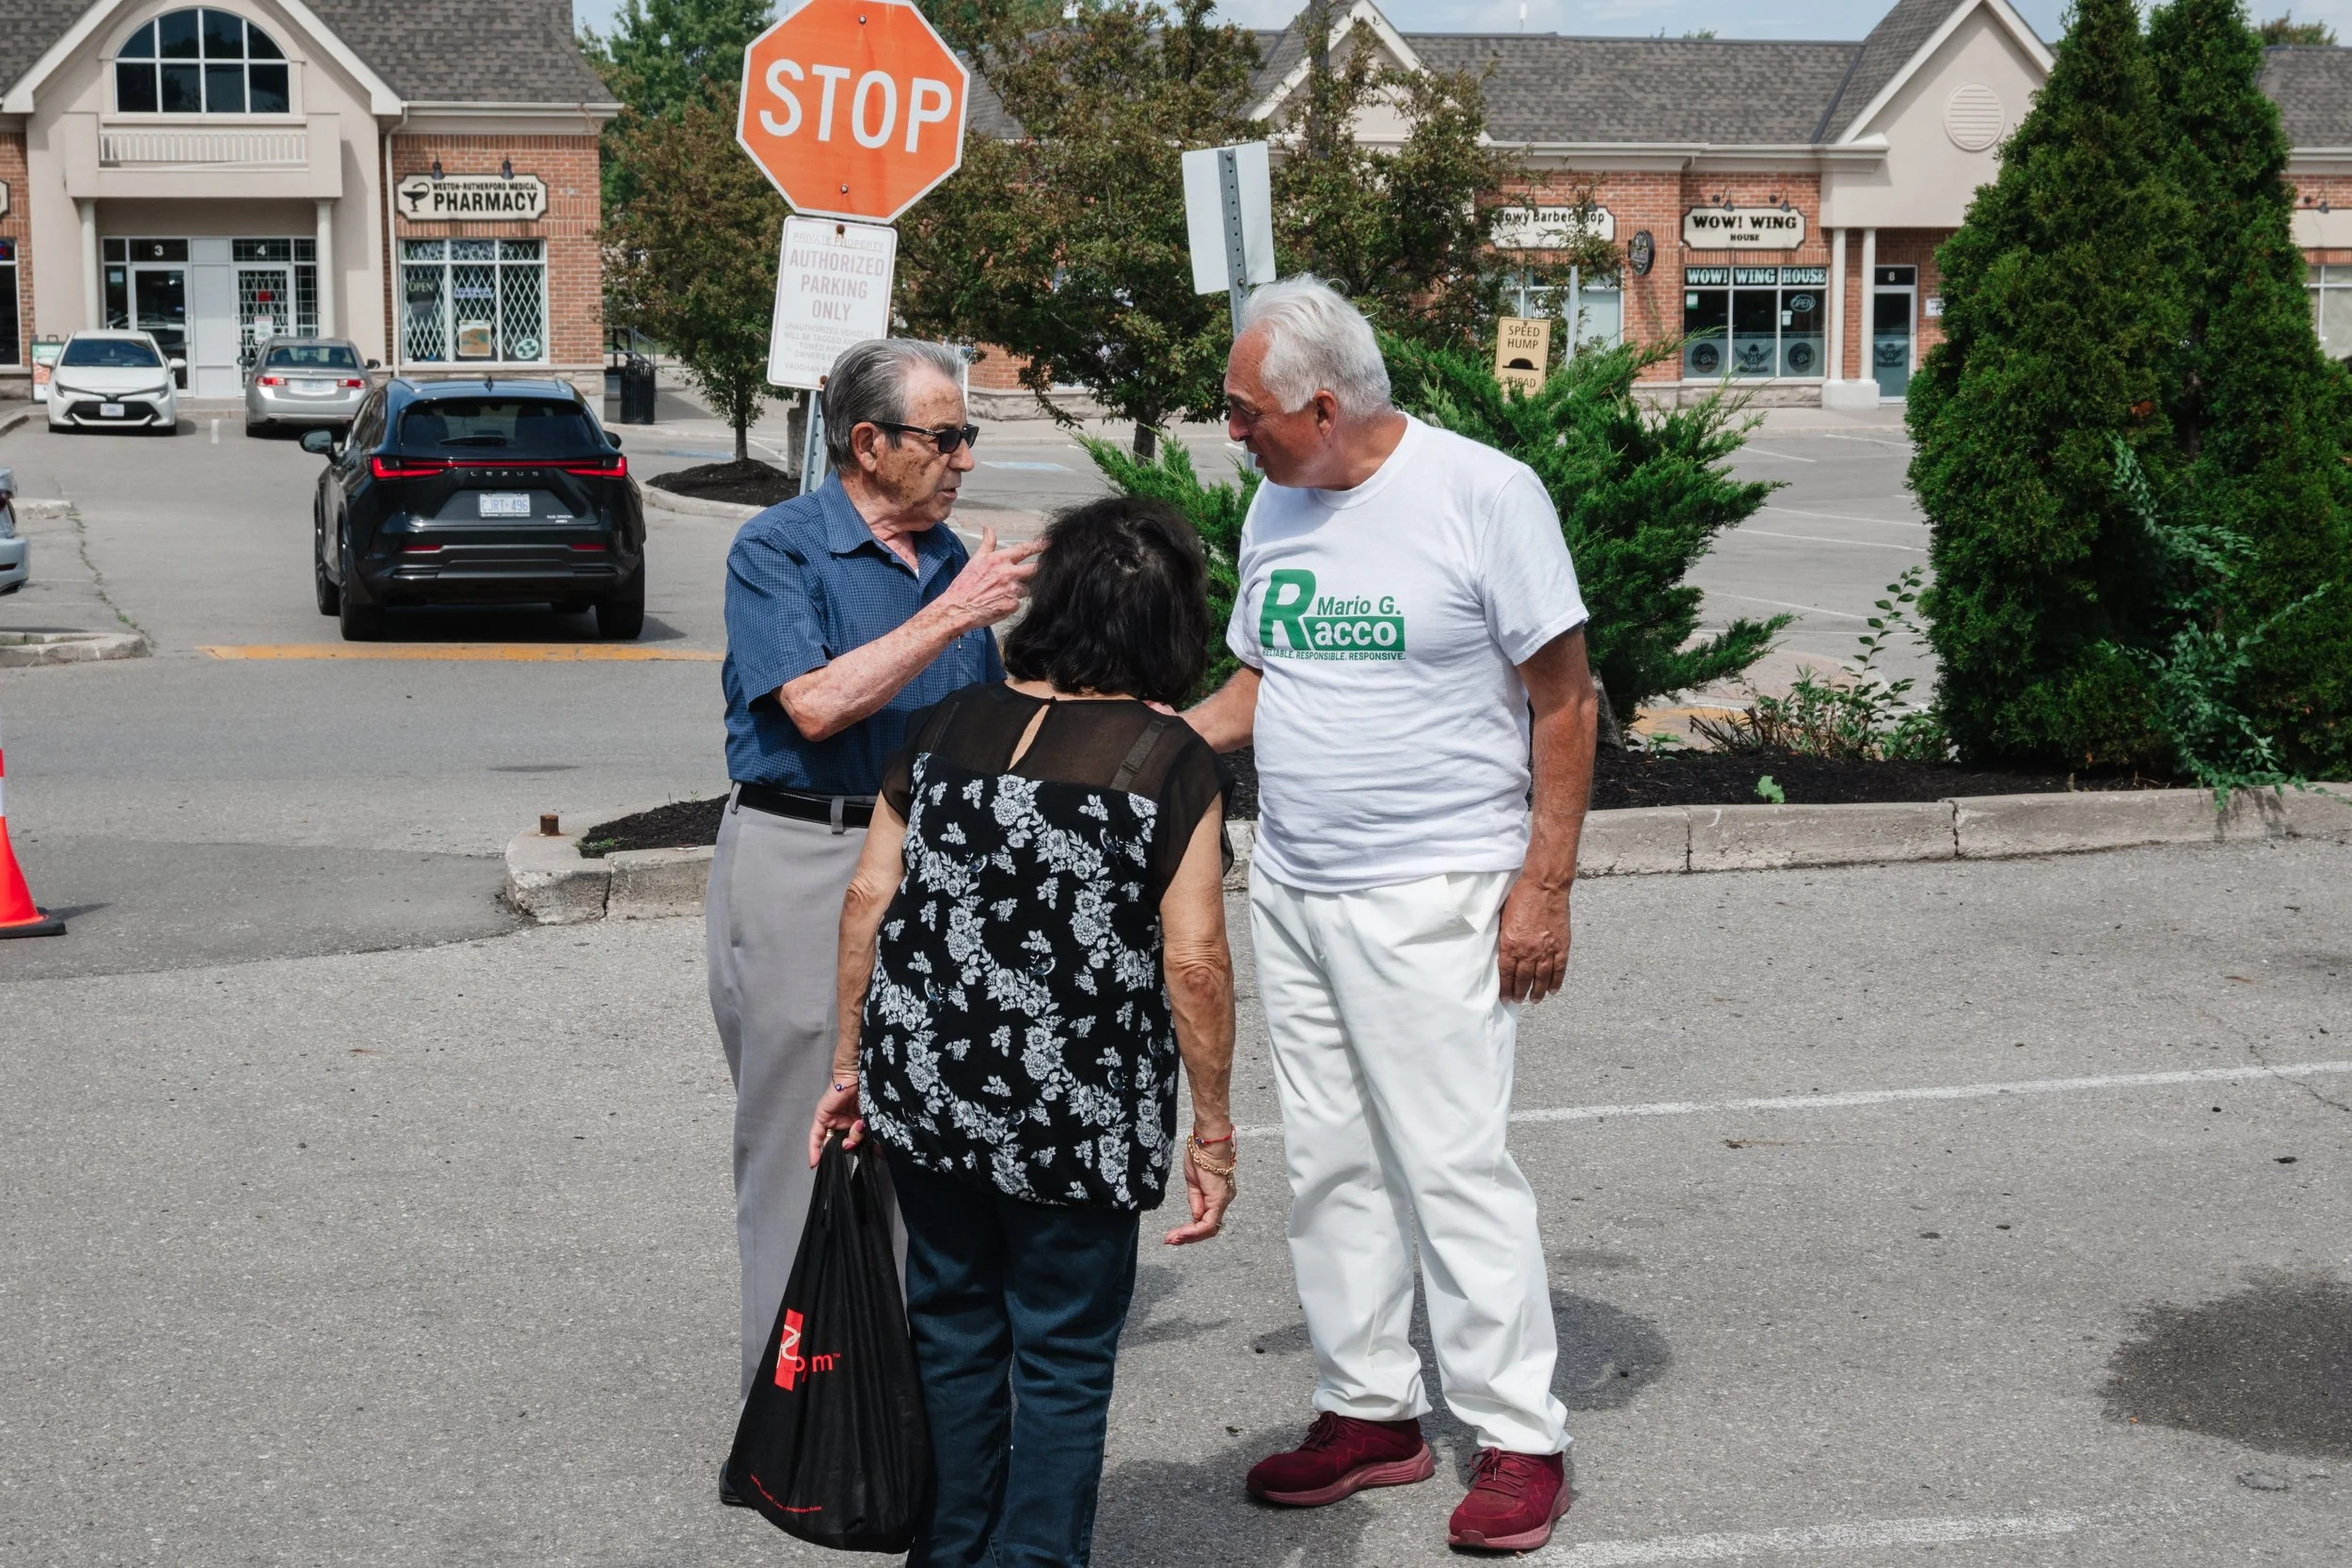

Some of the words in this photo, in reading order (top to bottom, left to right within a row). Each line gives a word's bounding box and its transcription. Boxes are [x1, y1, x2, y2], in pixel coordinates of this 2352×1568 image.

[760, 58, 952, 153] STOP
[432, 182, 507, 191] WESTON-RUTHERFORD
[509, 182, 538, 191] MEDICAL
[434, 192, 538, 212] PHARMACY
[1692, 215, 1743, 229] WOW!
[1750, 216, 1797, 229] WING
[793, 232, 831, 244] PRIVATE
[834, 236, 884, 249] PROPERTY
[154, 245, 164, 256] 3
[257, 245, 266, 256] 4
[789, 248, 884, 276] AUTHORIZED
[1687, 269, 1728, 283] WOW!
[1735, 269, 1776, 283] WING
[1783, 268, 1825, 283] HOUSE
[1888, 271, 1896, 281] 8
[408, 283, 435, 293] OPEN
[801, 274, 868, 299] PARKING
[812, 299, 851, 321] ONLY
[784, 331, 800, 340] WILL
[802, 332, 812, 341] BE
[813, 333, 842, 344] TAGGED
[785, 323, 838, 335] UNAUTHORIZED
[840, 328, 874, 339] VEHICLES
[1508, 325, 1540, 337] SPEED
[799, 341, 824, 351] TOWED
[1507, 338, 1538, 349] HUMP
[784, 362, 819, 372] VAUGHAN
[1260, 569, 1397, 651] Racco
[1317, 595, 1371, 616] Mario
[1379, 595, 1402, 615] G.
[1262, 647, 1295, 659] RELIABLE.
[1296, 651, 1346, 660] RESPONSIBLE.
[1349, 652, 1406, 660] RESPONSIVE.
